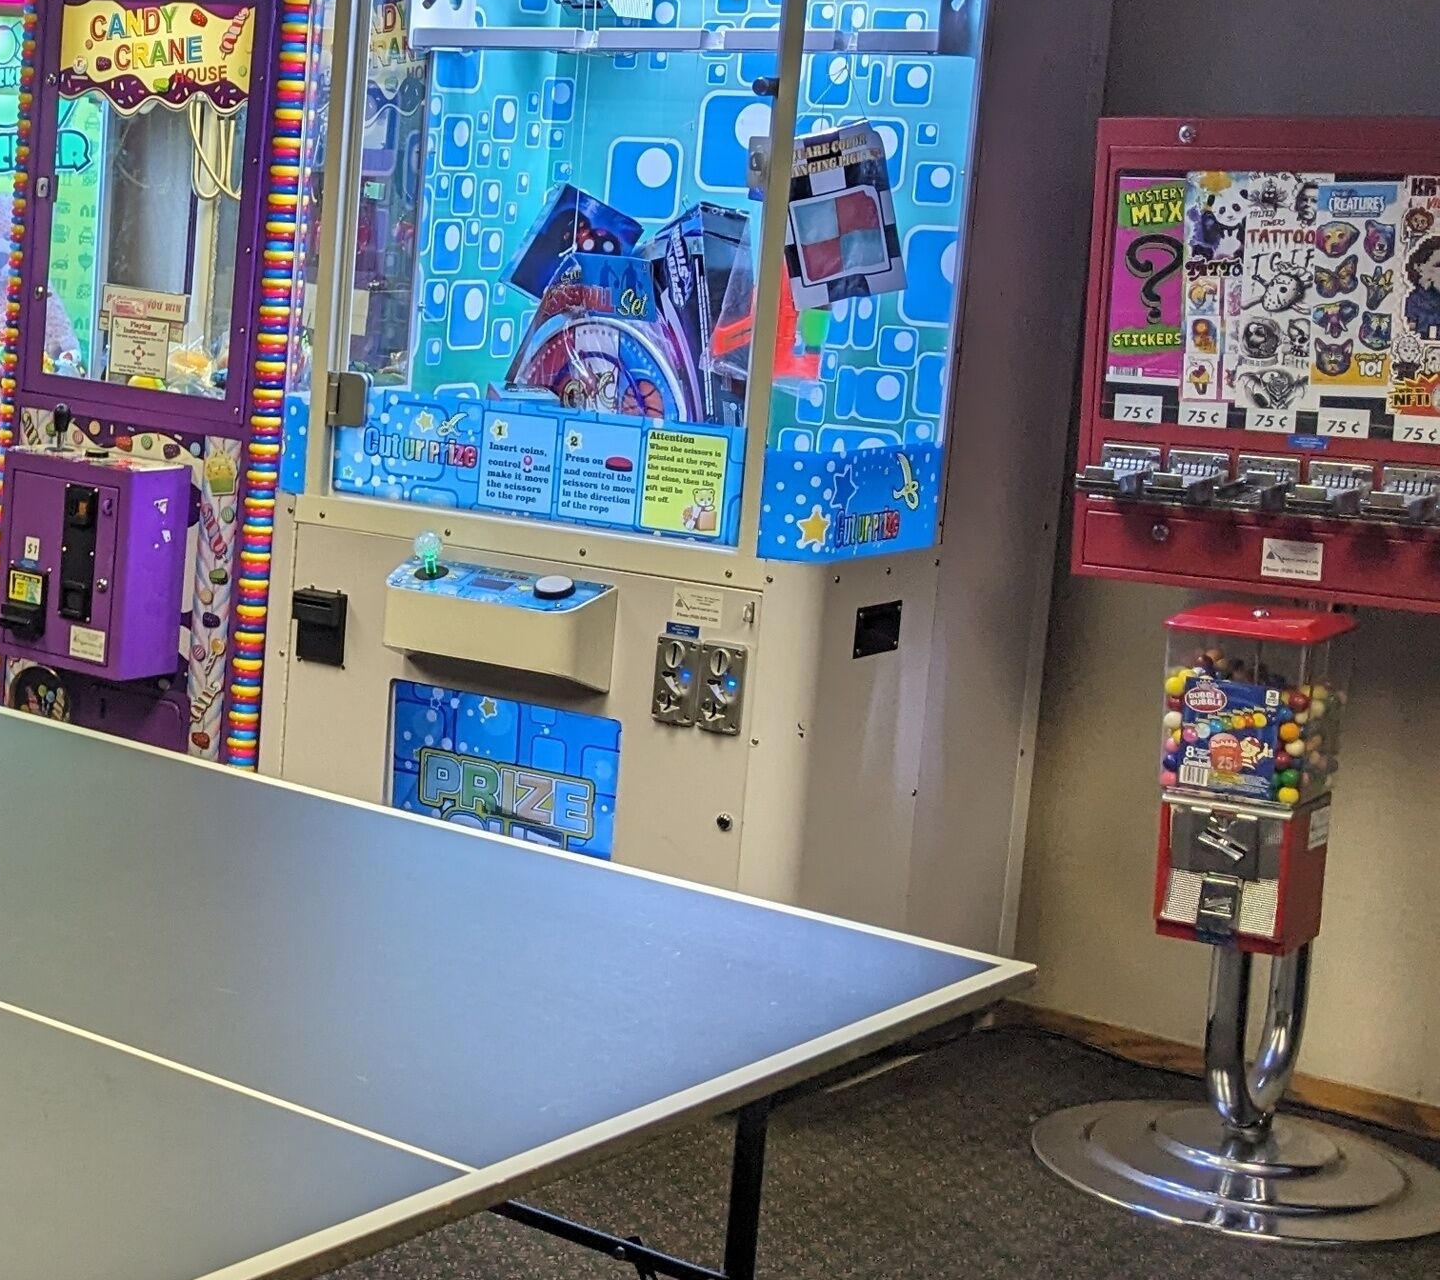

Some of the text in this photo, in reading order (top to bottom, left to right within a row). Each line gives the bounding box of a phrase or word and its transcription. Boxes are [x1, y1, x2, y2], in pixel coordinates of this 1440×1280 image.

[90, 6, 178, 41] CANDY
[114, 35, 203, 71] CRANE
[175, 65, 227, 83] HOUSE
[791, 159, 837, 179] ANGING
[1125, 187, 1184, 205] MYSTERY
[1131, 201, 1183, 226] MIX
[617, 288, 647, 317] Set
[1113, 332, 1182, 347] STICKERS
[497, 426, 503, 436] 1
[650, 431, 695, 444] Attention
[363, 426, 401, 459] Cut
[403, 437, 426, 461] ur
[489, 442, 517, 453] Insert
[570, 436, 578, 447] 2
[649, 443, 669, 452] When
[684, 447, 713, 456] scissors
[565, 453, 590, 463] Press
[648, 454, 674, 462] pointed
[686, 457, 697, 465] the
[488, 459, 551, 473] control and
[661, 465, 689, 474] scissors
[706, 471, 722, 480] stop
[487, 470, 549, 484] make it move
[563, 468, 632, 482] and control the
[486, 479, 541, 494] the scissors
[563, 479, 636, 494] scissors to move
[660, 485, 673, 493] will
[486, 489, 536, 504] to the rope
[562, 488, 630, 505] in the direction
[561, 500, 609, 514] of the rope
[27, 543, 38, 554] $1
[1188, 691, 1222, 700] DUBBLE
[1189, 698, 1223, 707] BUBBLE
[1185, 745, 1194, 758] 8
[423, 751, 591, 835] PRIZE
